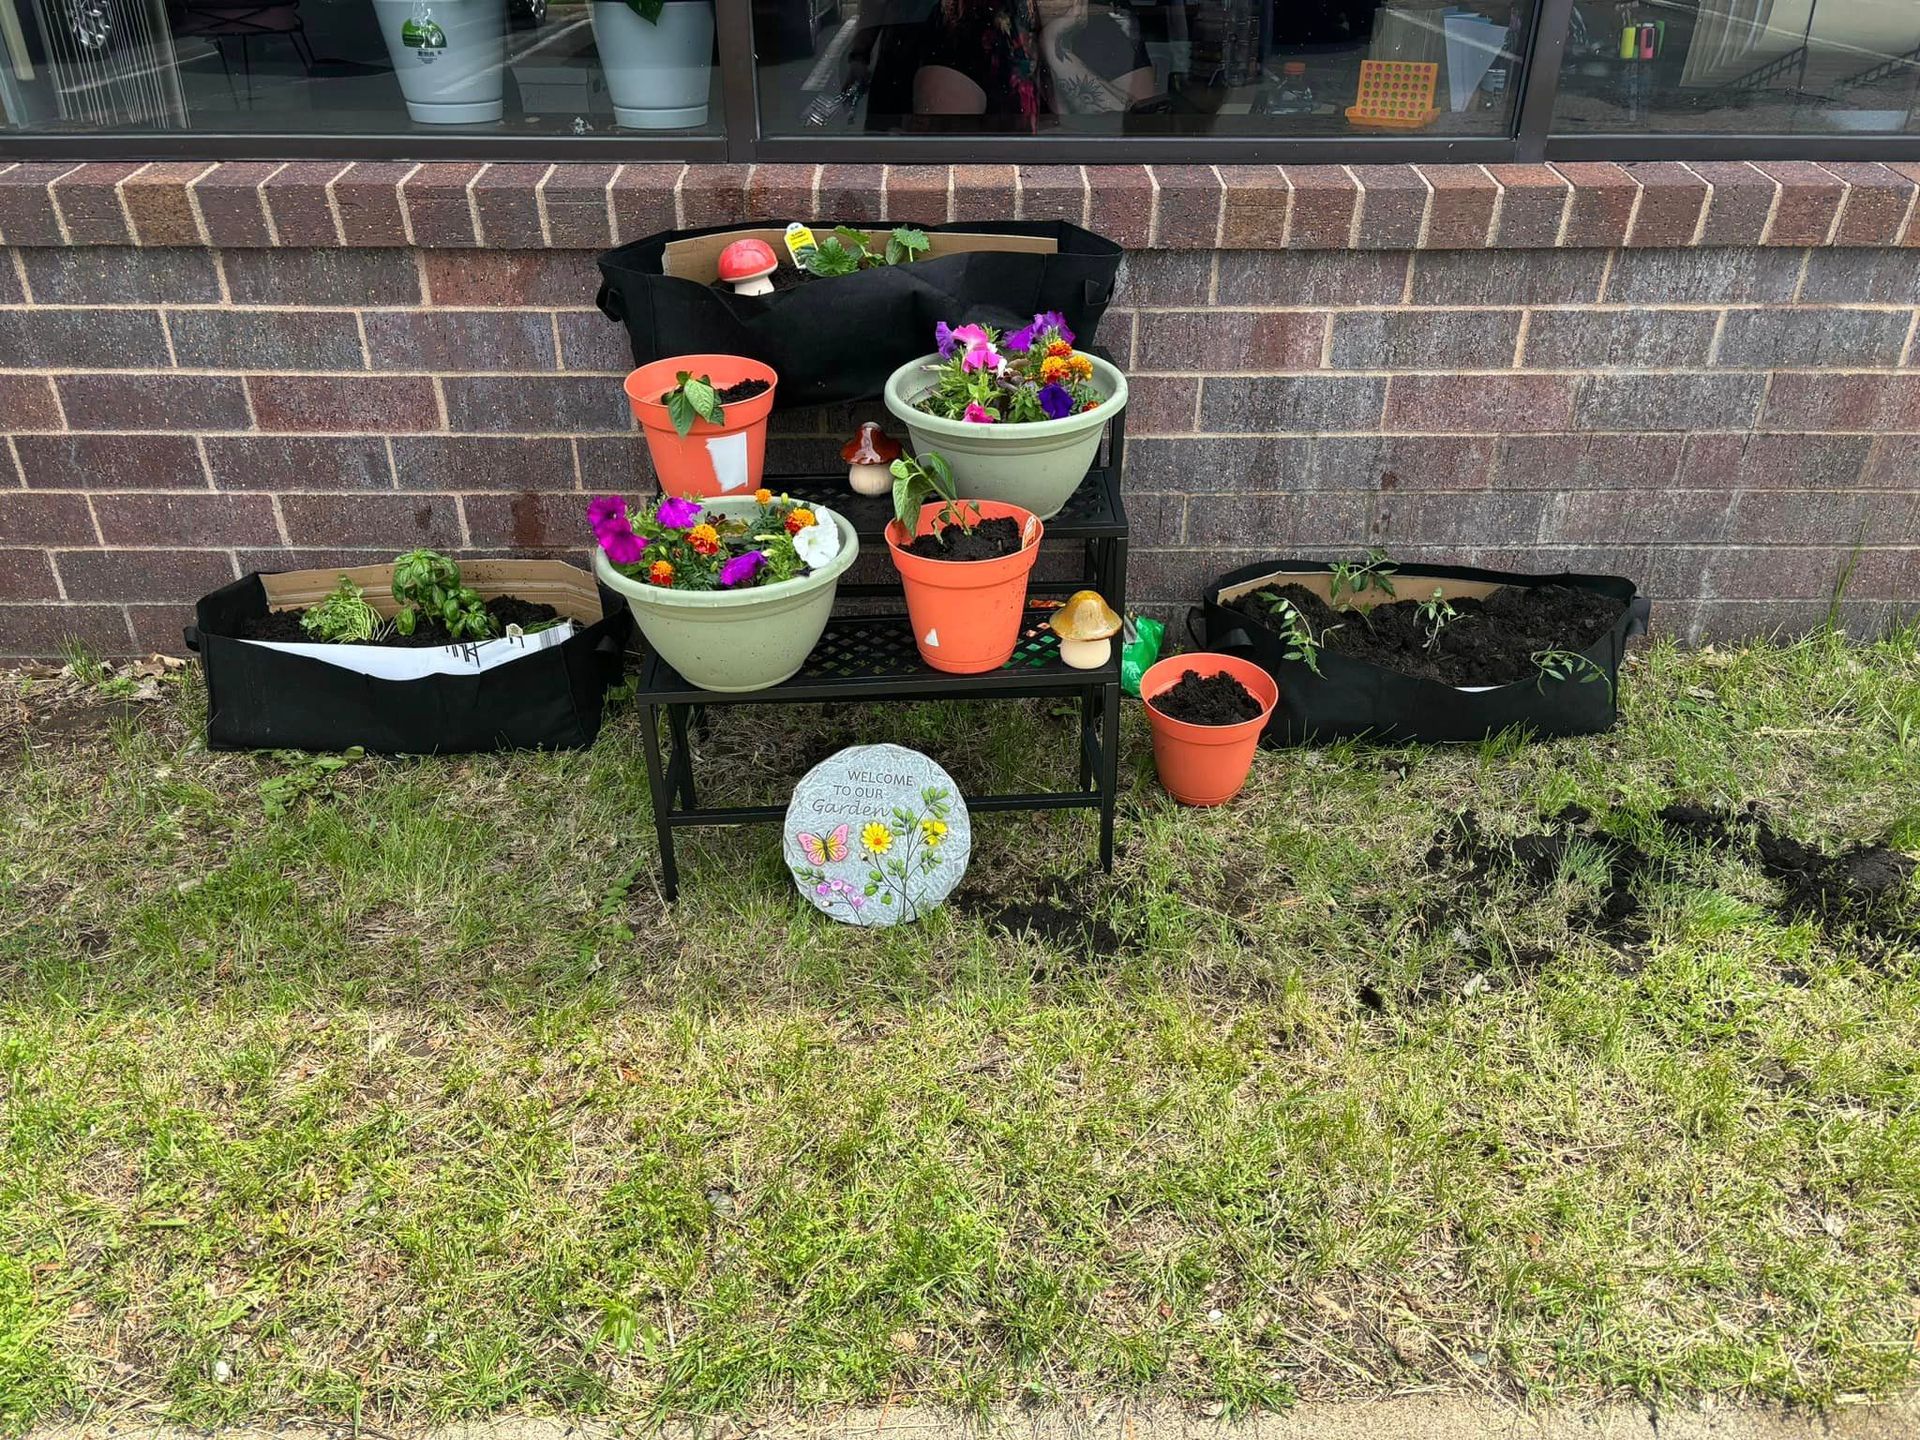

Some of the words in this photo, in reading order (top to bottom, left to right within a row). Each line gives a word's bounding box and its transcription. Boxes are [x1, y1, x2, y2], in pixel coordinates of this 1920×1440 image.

[847, 770, 913, 786] WELCOME
[833, 785, 851, 796] TO
[855, 787, 883, 799] OUR
[812, 798, 890, 817] Garden
